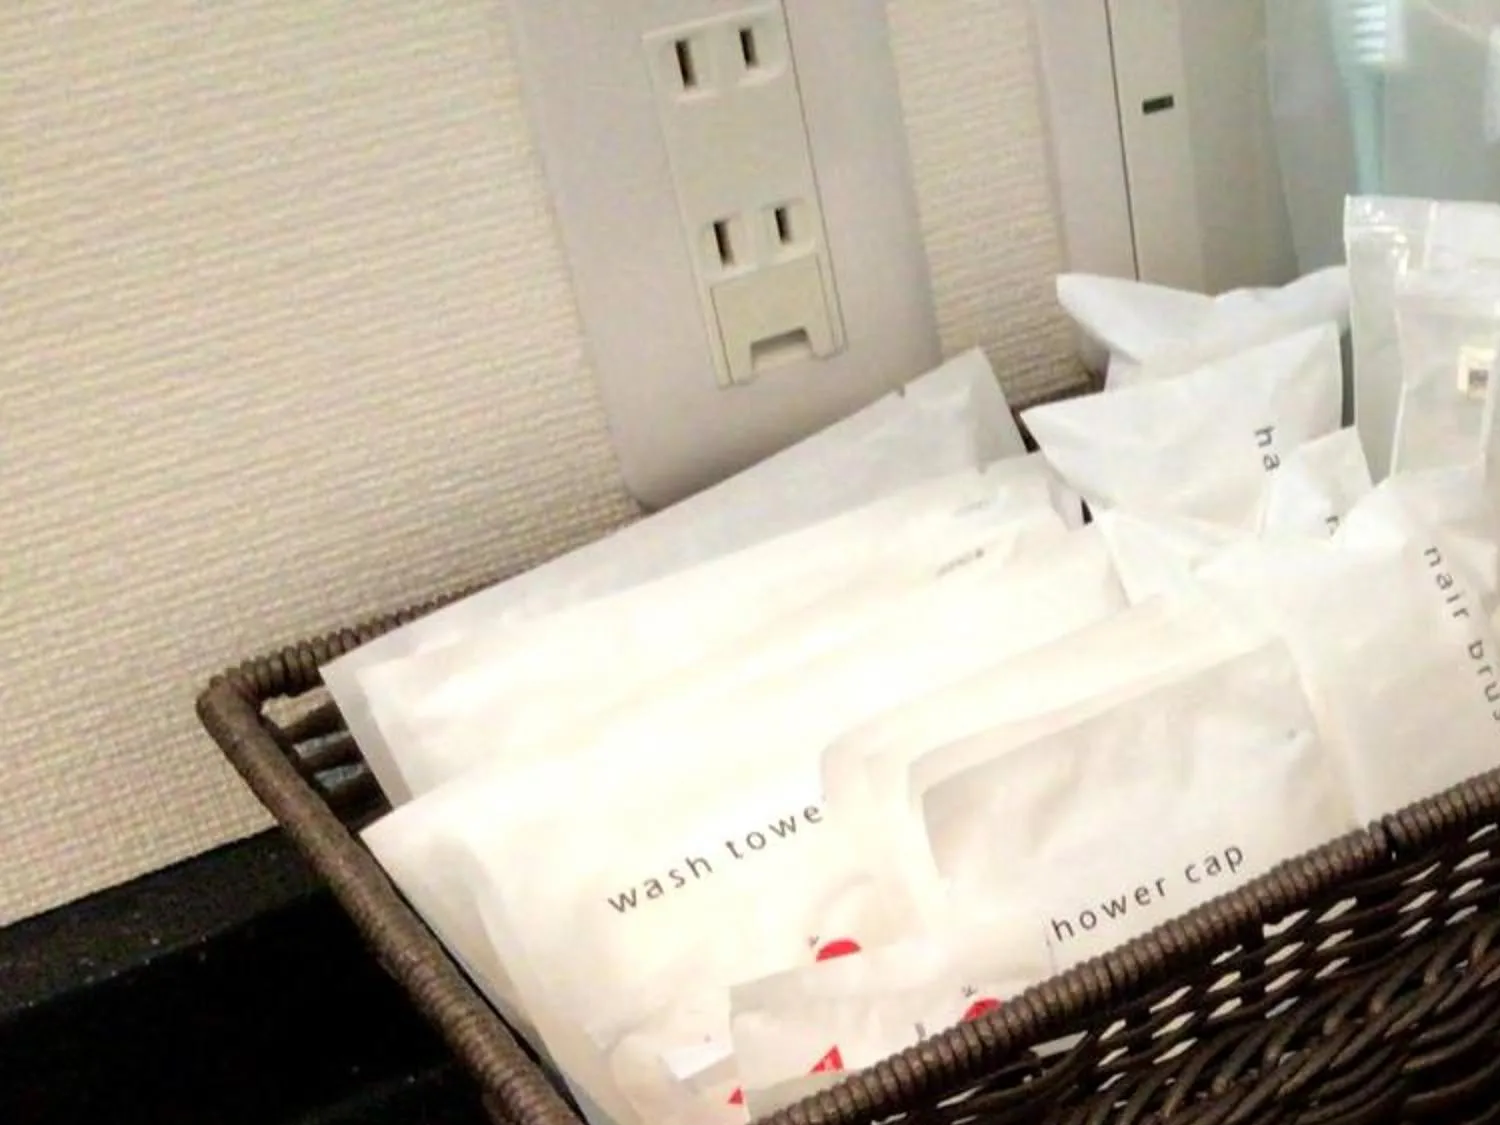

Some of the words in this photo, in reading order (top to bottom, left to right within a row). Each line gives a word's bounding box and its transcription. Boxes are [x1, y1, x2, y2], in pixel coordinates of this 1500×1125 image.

[607, 855, 713, 914] wash
[724, 803, 825, 860] towe
[1050, 876, 1168, 942] hower
[1184, 846, 1244, 884] cap
